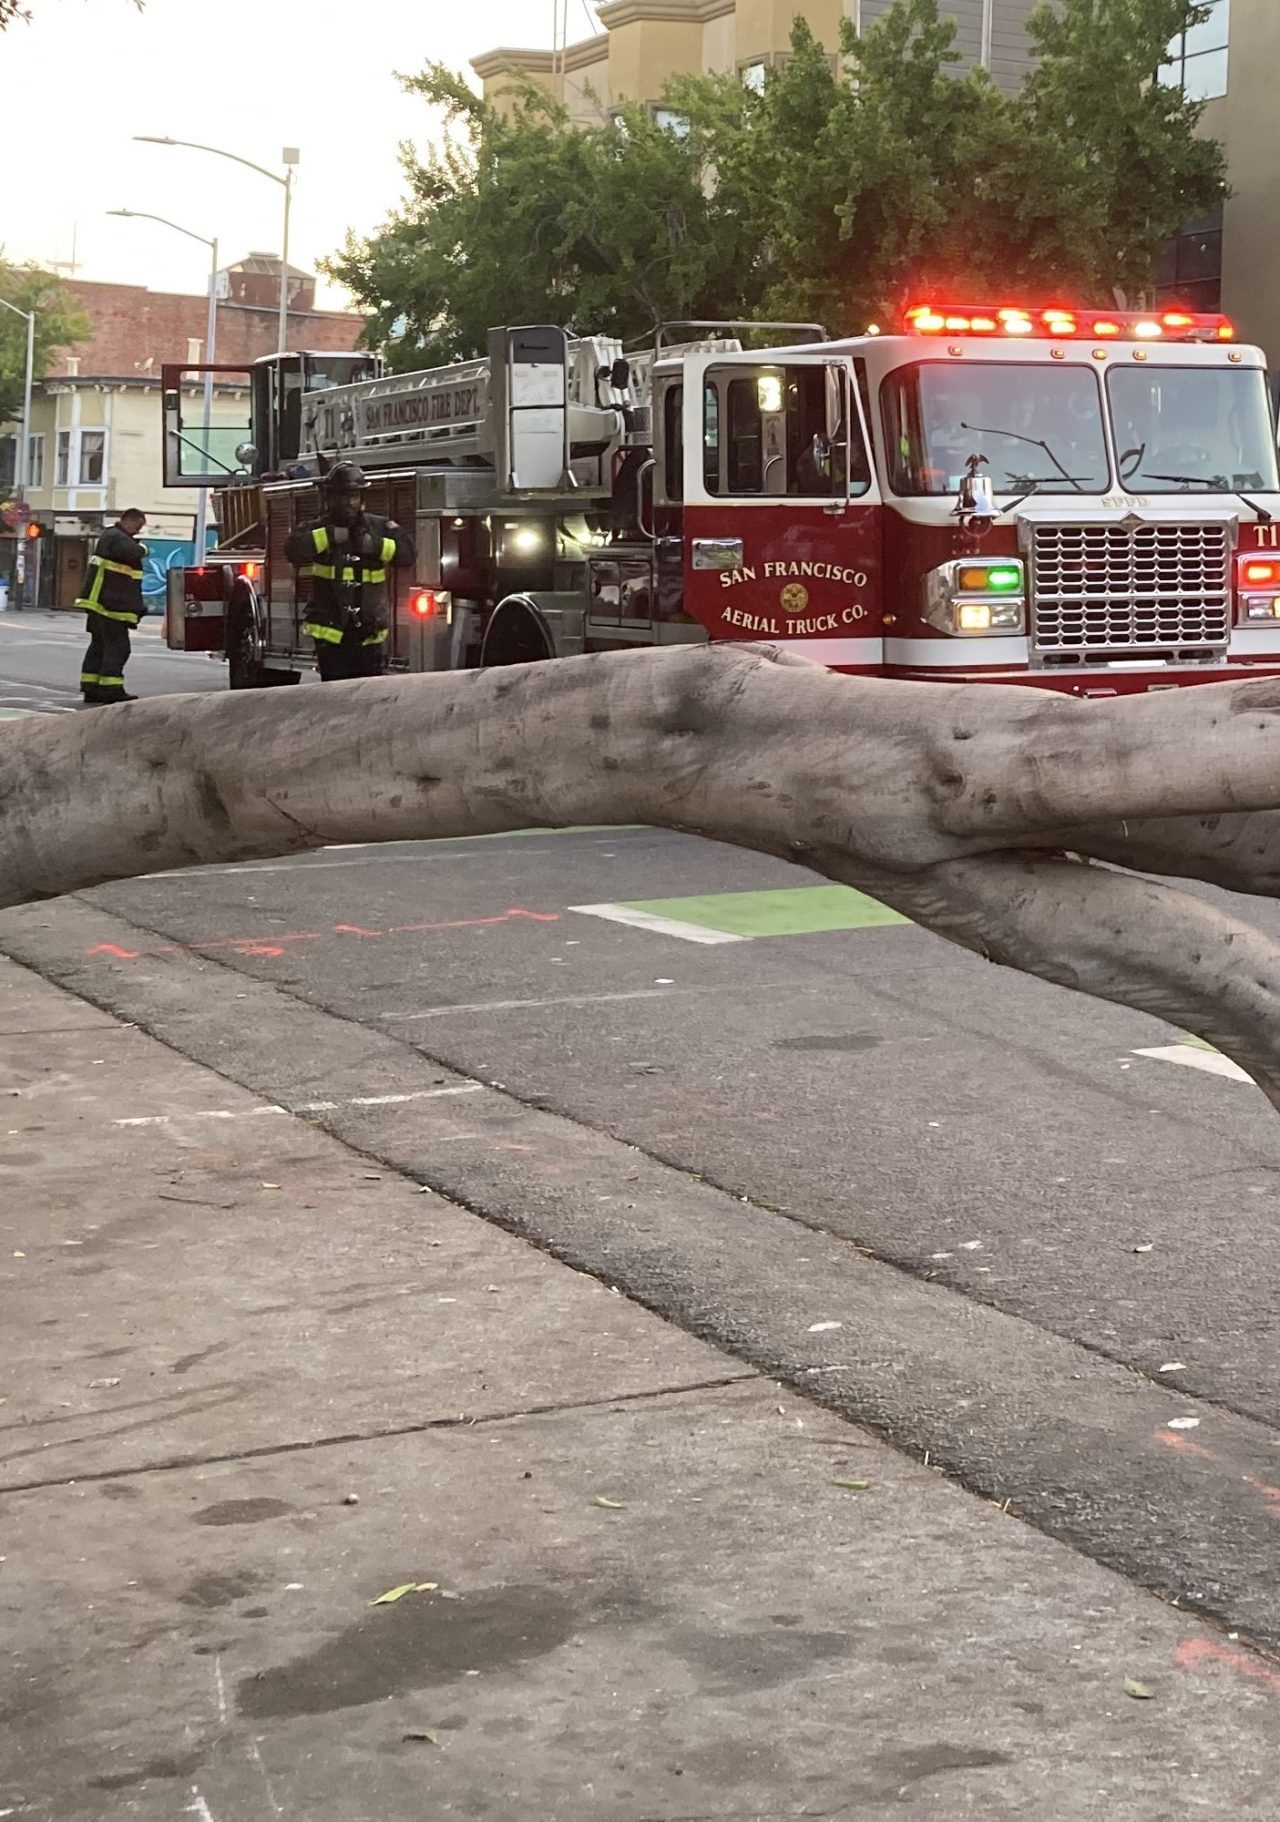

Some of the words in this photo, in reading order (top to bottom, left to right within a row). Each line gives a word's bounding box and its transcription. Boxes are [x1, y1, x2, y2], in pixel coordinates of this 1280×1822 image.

[366, 403, 381, 429] SAN
[383, 396, 429, 426] FRANCISCO
[431, 391, 451, 419] FIRE
[454, 387, 480, 417] DEPT.
[1253, 525, 1277, 547] T1
[719, 566, 756, 588] SAN
[764, 561, 867, 587] FRANCISCO
[720, 605, 780, 634] AERIAL
[786, 613, 838, 634] TRUCK
[841, 604, 869, 624] CO.
